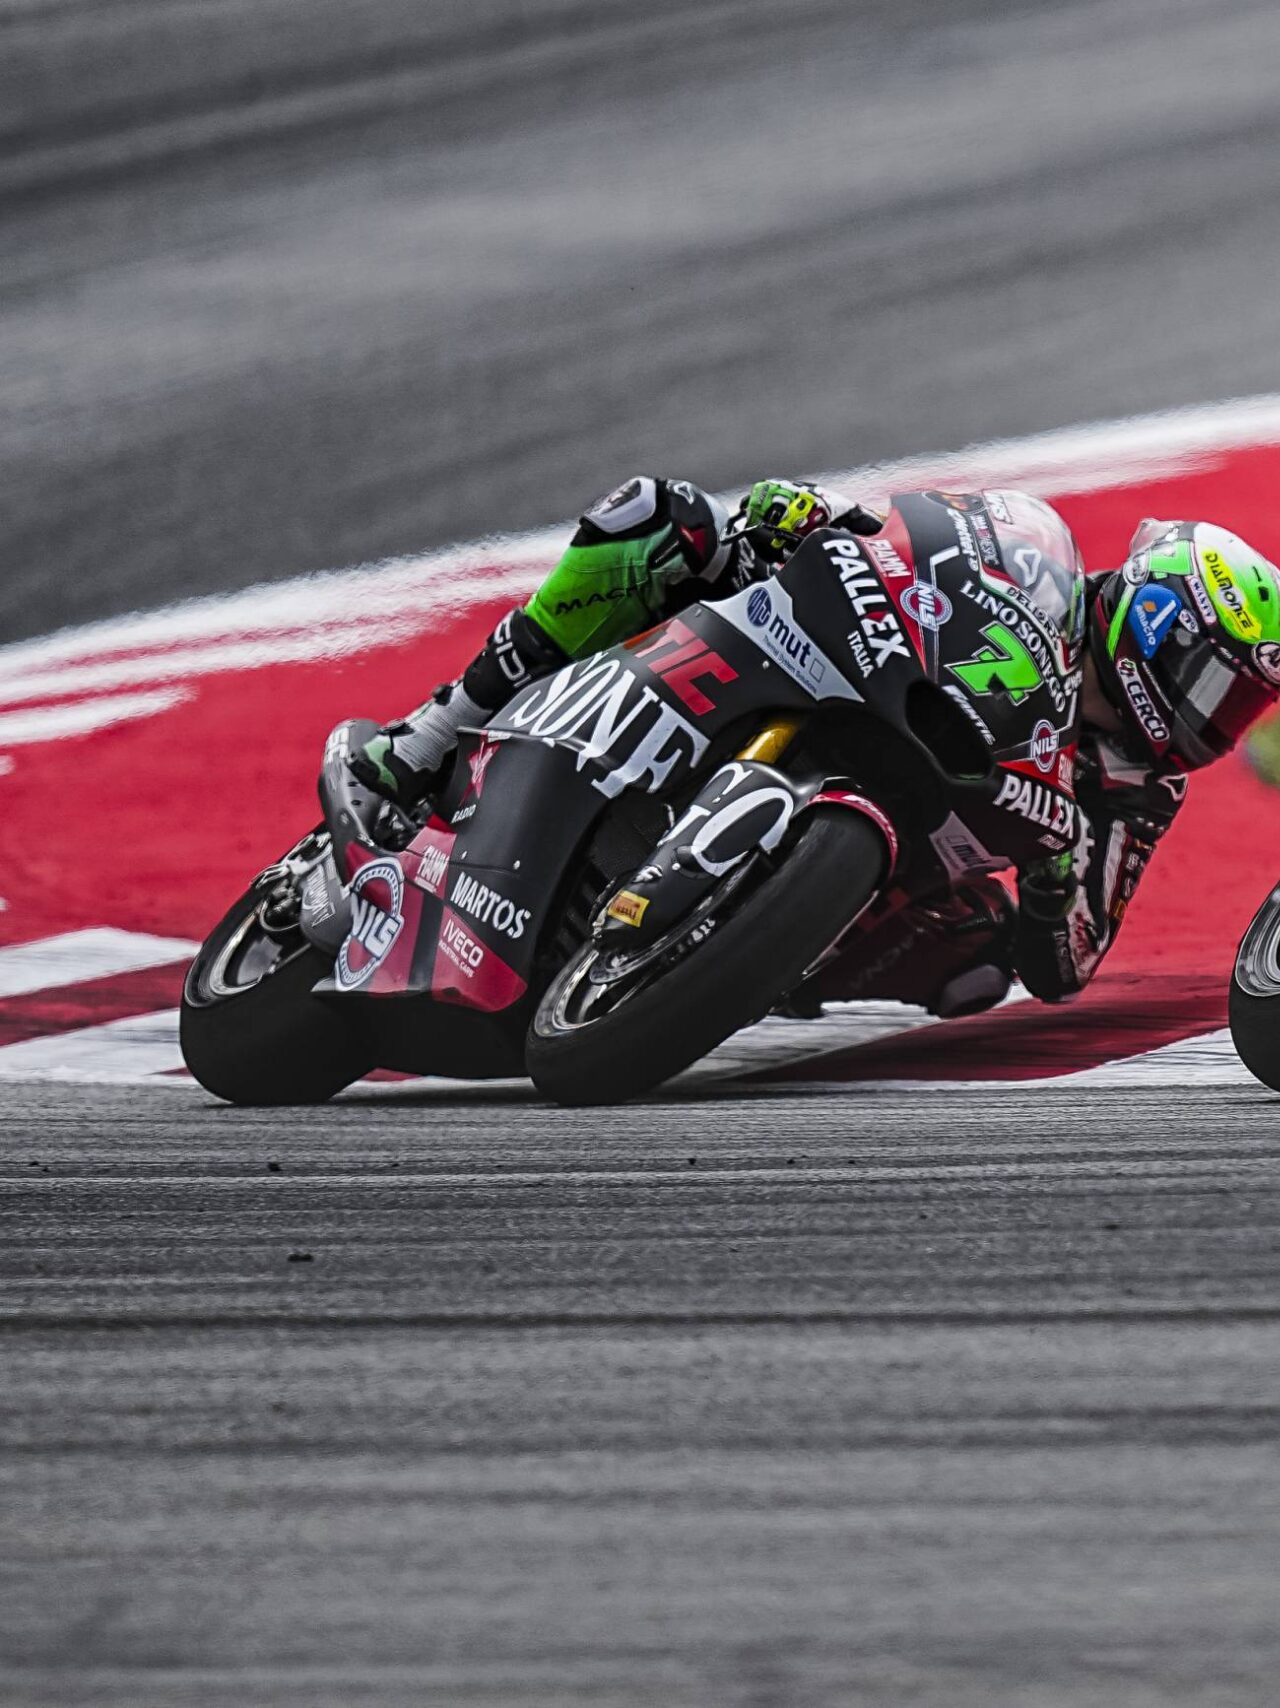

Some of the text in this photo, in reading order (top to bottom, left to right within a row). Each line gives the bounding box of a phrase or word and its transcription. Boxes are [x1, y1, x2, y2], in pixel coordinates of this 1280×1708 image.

[822, 539, 912, 669] PALLEX
[769, 613, 811, 668] mut
[847, 630, 875, 679] ITALIA
[943, 620, 1045, 707] 7
[959, 580, 1018, 627] LINO
[1016, 620, 1066, 713] SONEGO
[1127, 679, 1167, 740] CERCO
[1032, 735, 1058, 758] NILS
[451, 803, 477, 824] RADIO
[993, 773, 1075, 840] PALLEX
[450, 872, 532, 939] MARTOS
[443, 918, 484, 968] IVECO
